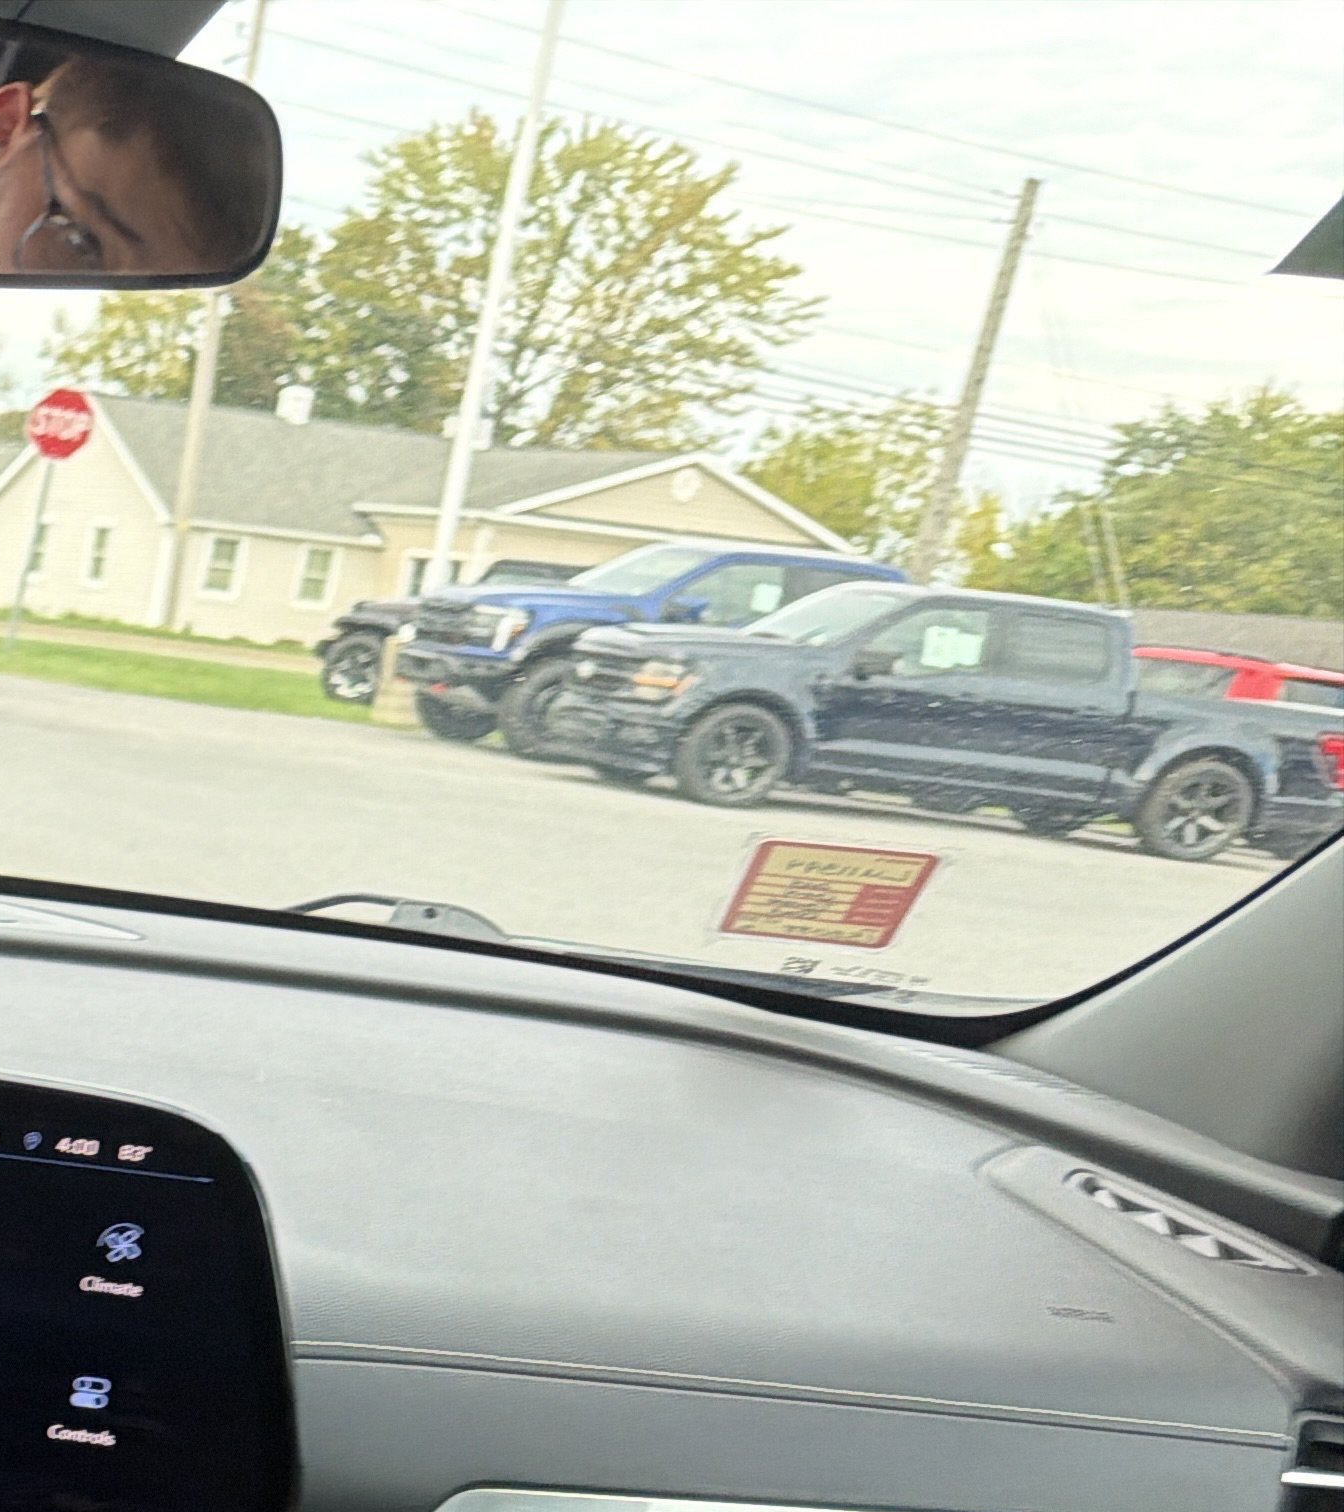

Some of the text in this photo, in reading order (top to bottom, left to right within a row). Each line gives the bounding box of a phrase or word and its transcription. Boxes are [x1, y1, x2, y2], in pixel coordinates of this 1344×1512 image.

[31, 406, 89, 440] STOP
[78, 1275, 145, 1298] Climate
[46, 1423, 117, 1447] Controls
